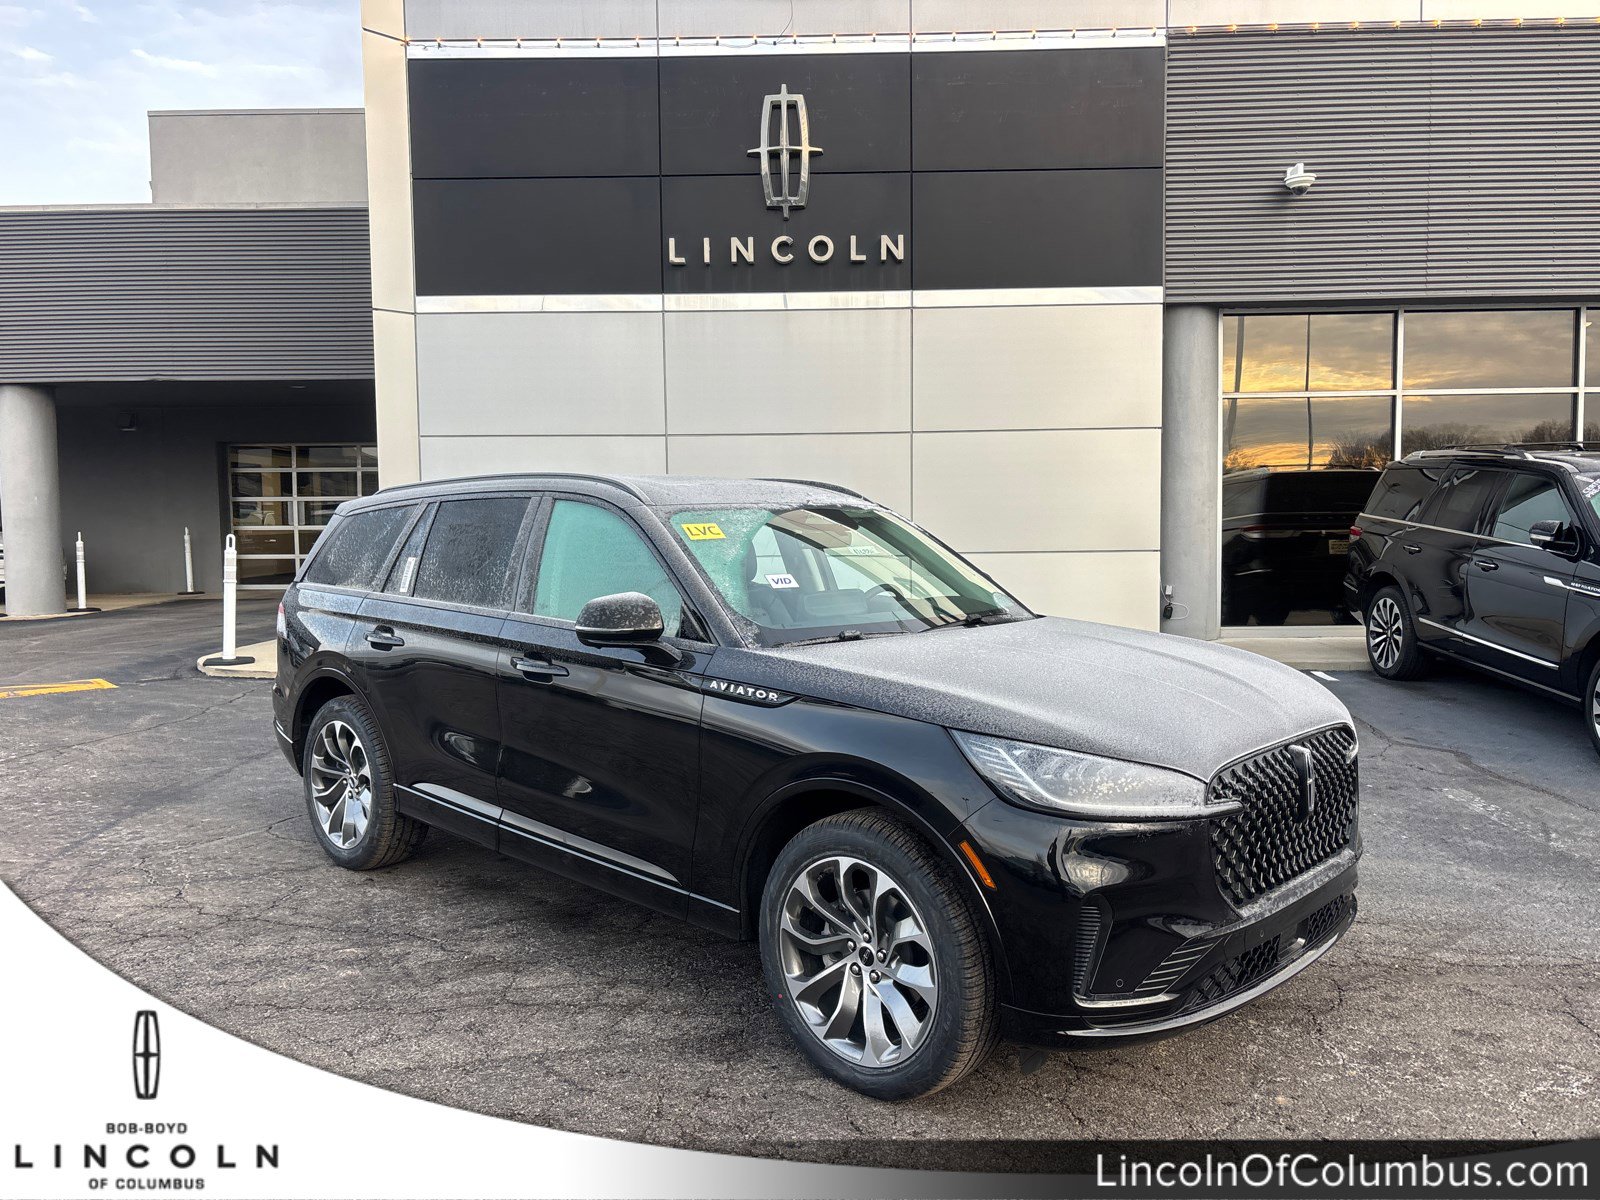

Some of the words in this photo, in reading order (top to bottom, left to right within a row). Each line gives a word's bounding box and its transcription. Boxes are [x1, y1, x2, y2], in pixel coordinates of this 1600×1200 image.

[668, 234, 905, 265] LINCOLN
[686, 526, 721, 536] LVC
[771, 577, 792, 585] VID
[709, 680, 779, 701] AVIATOR
